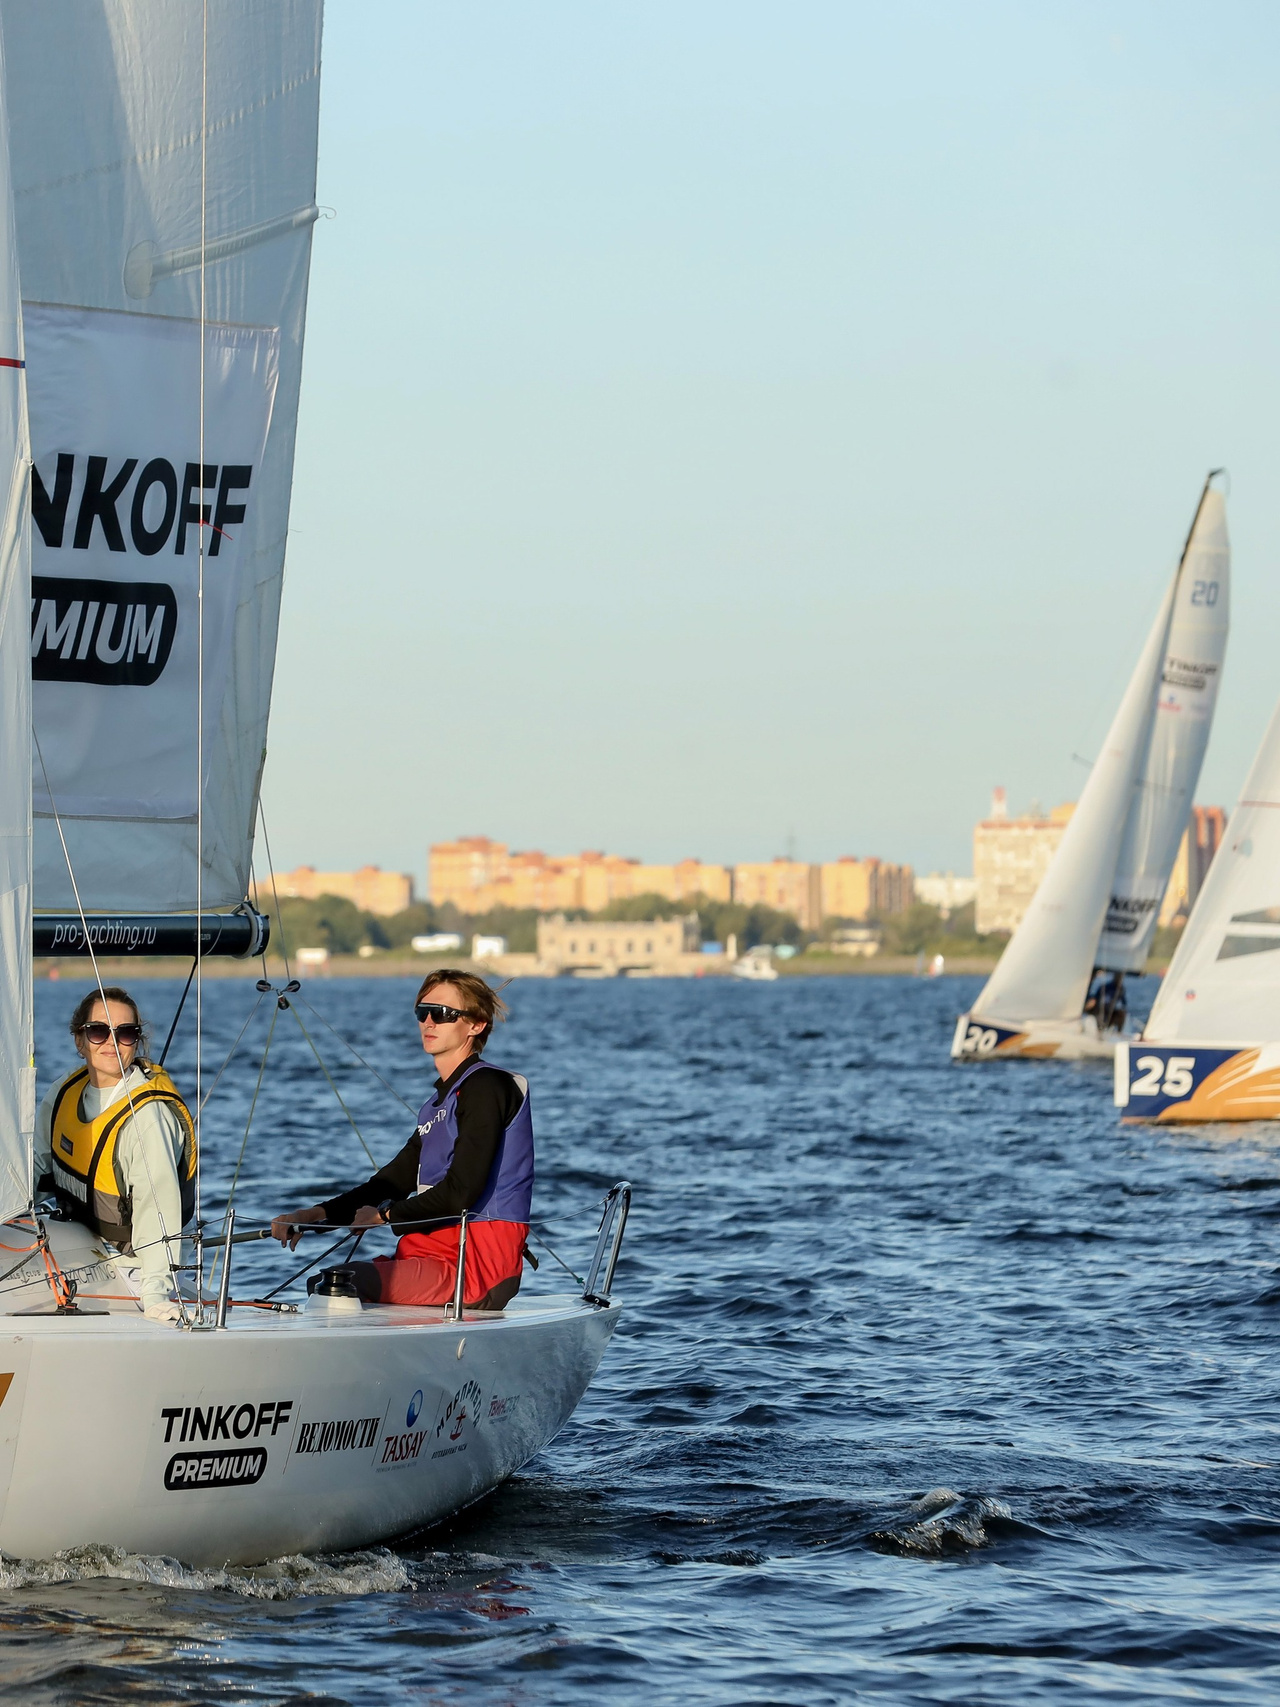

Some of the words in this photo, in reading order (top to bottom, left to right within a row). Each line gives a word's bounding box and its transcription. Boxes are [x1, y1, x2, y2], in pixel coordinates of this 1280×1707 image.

[31, 452, 253, 557] NKOFF
[1191, 580, 1219, 607] 20
[32, 597, 166, 664] MIUM
[51, 919, 157, 950] pro-yachting.ru
[964, 1026, 998, 1050] 20
[1130, 1056, 1196, 1097] 25
[161, 1401, 293, 1443] TINKOFF
[295, 1418, 380, 1457] ВЕДОМОСТИ
[381, 1430, 428, 1463] TASSAY
[170, 1454, 263, 1483] PREMIUM
